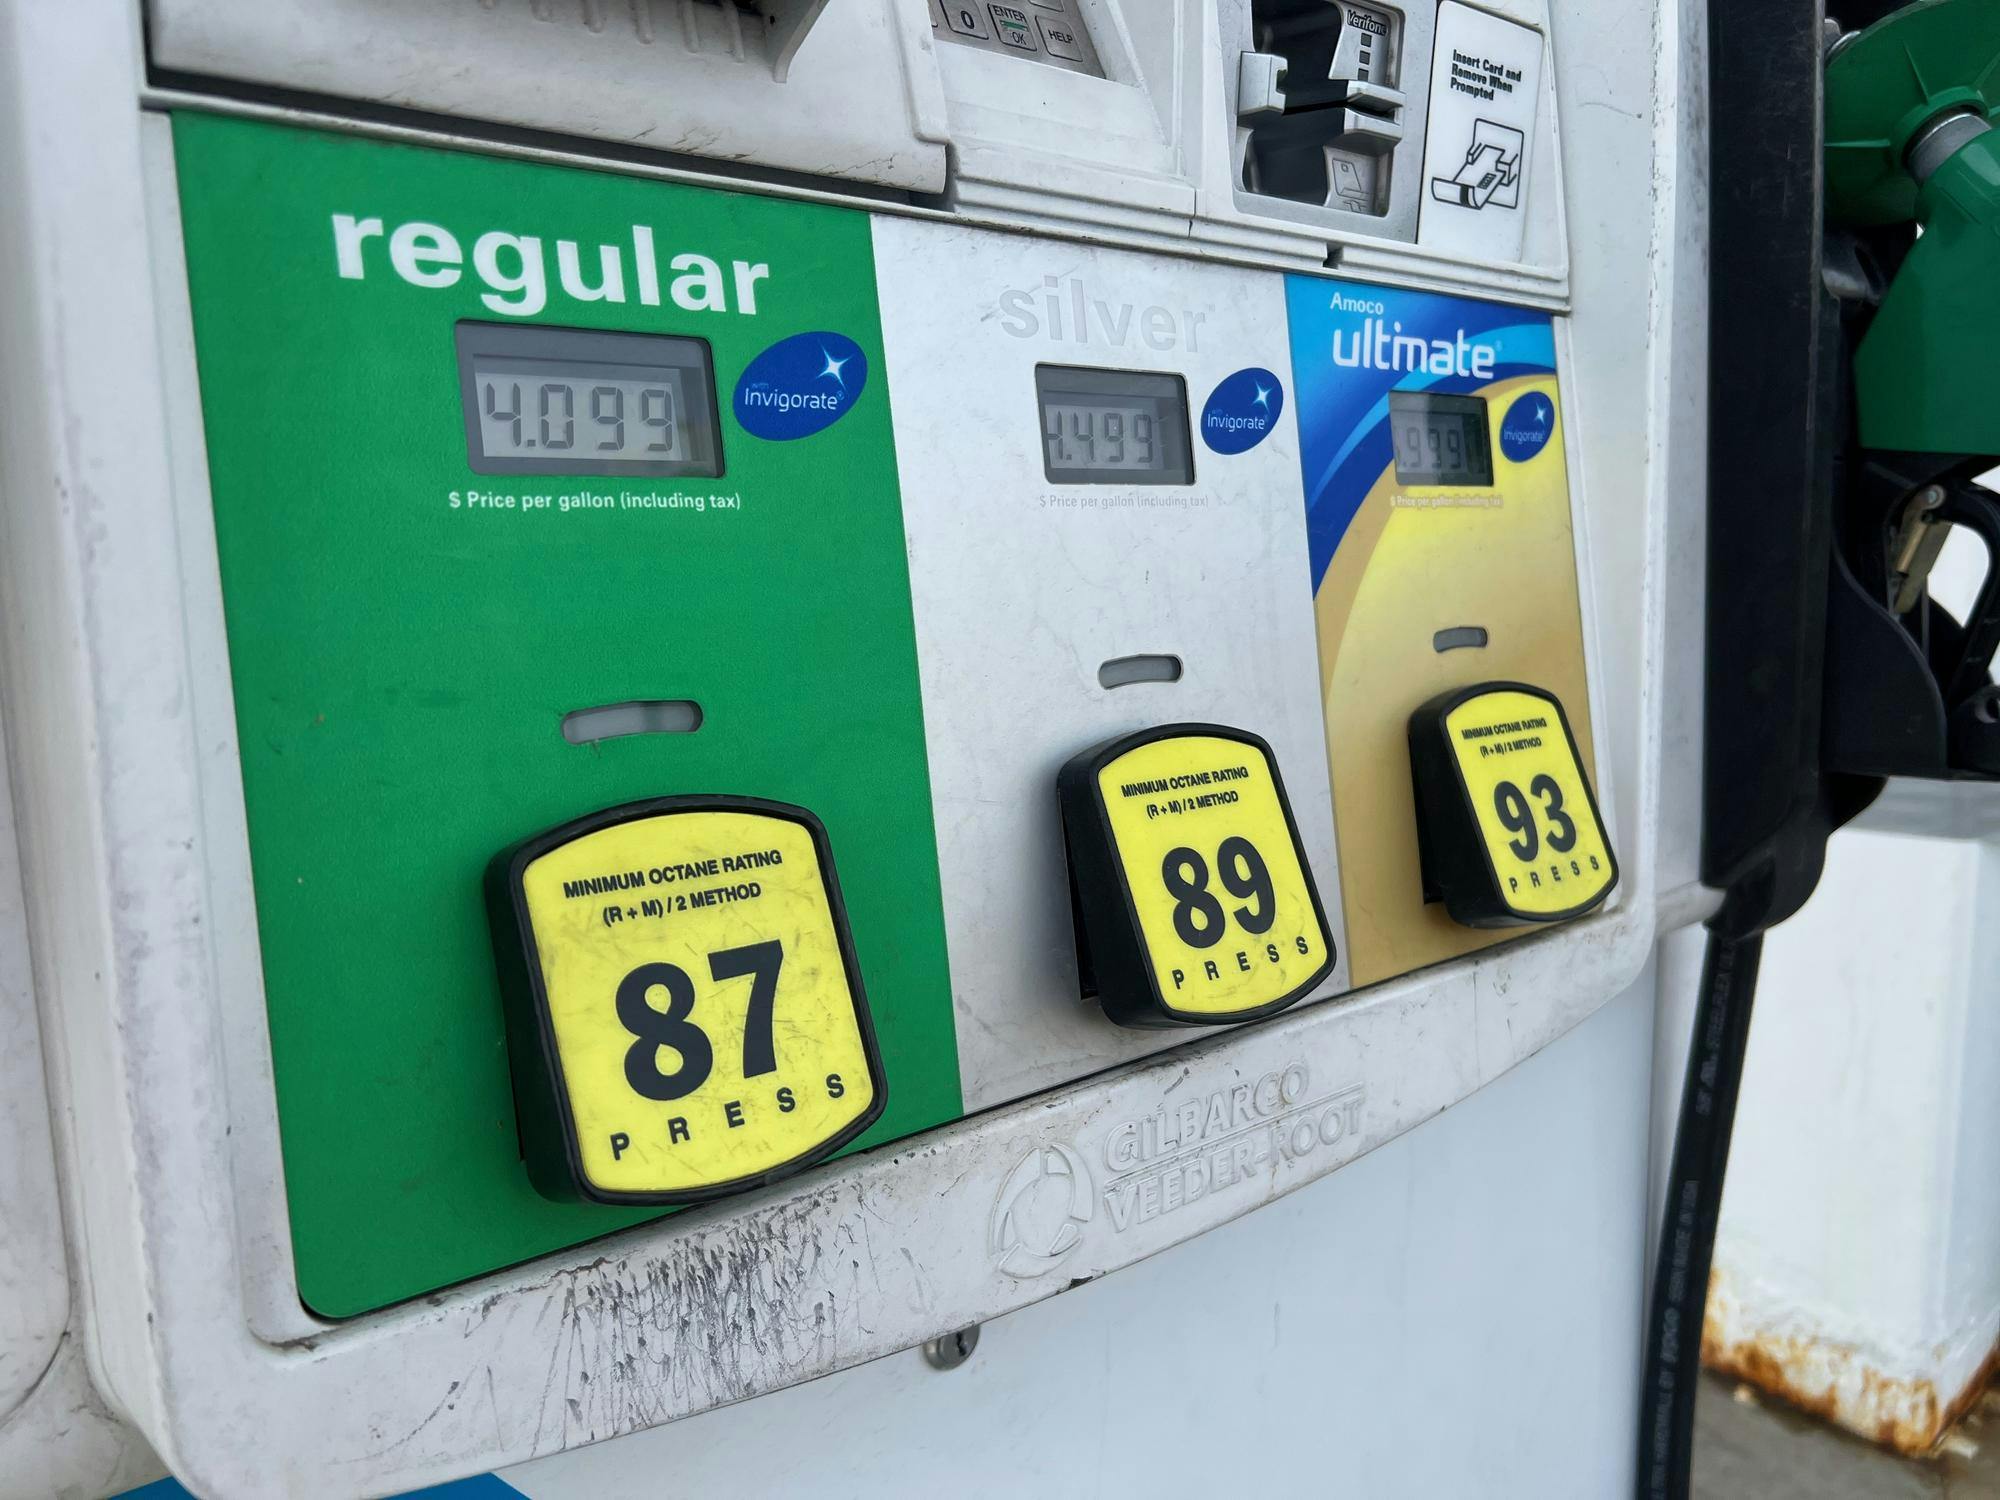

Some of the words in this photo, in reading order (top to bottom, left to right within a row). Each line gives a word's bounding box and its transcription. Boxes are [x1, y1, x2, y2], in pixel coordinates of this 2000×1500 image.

[994, 7, 1025, 22] ENTER
[1012, 31, 1027, 46] OK
[1048, 29, 1073, 44] HELP
[1451, 63, 1487, 85] Remove
[1489, 75, 1512, 93] When
[1453, 49, 1480, 69] Insert
[1483, 59, 1504, 76] Card
[1506, 70, 1522, 82] and
[1450, 77, 1494, 101] Prompted
[332, 214, 769, 316] regular
[1000, 275, 1206, 352] silver
[1330, 291, 1384, 315] Amoco
[1333, 318, 1496, 379] ultimate
[745, 388, 838, 412] Invigorate
[485, 382, 673, 452] 4.099
[1208, 413, 1265, 432] Invigorate
[449, 491, 460, 508] $
[467, 491, 515, 508] Price
[522, 495, 551, 511] per
[559, 492, 615, 512] gallon
[620, 492, 704, 512] (including
[710, 492, 740, 511] tax)
[1050, 495, 1077, 507] Price
[1081, 498, 1097, 509] per
[1102, 496, 1134, 510] gallon
[1461, 726, 1493, 740] MINIMUM
[1493, 721, 1522, 735] OCTANE
[1522, 717, 1547, 731] RATING
[1512, 737, 1542, 750] METHOD
[1121, 779, 1169, 797] MINIMUM
[1169, 772, 1211, 789] OCTANE
[1211, 766, 1249, 783] RATING
[1188, 798, 1196, 810] 2
[1196, 790, 1239, 808] METHOD
[1494, 774, 1577, 862] 93
[563, 871, 646, 898] MINIMUM
[649, 859, 719, 884] OCTANE
[722, 849, 783, 872] RATING
[1509, 856, 1600, 893] PRESS
[602, 906, 623, 927] (R
[641, 899, 663, 918] M)
[677, 896, 687, 911] 2
[690, 882, 762, 908] METHOD
[1162, 836, 1276, 949] 89
[1172, 936, 1309, 989] PRESS
[616, 939, 784, 1100] 87
[610, 1073, 844, 1161] PRESS
[1103, 1061, 1311, 1173] GILBARCO
[1103, 1100, 1364, 1234] VEEDER-ROOT
